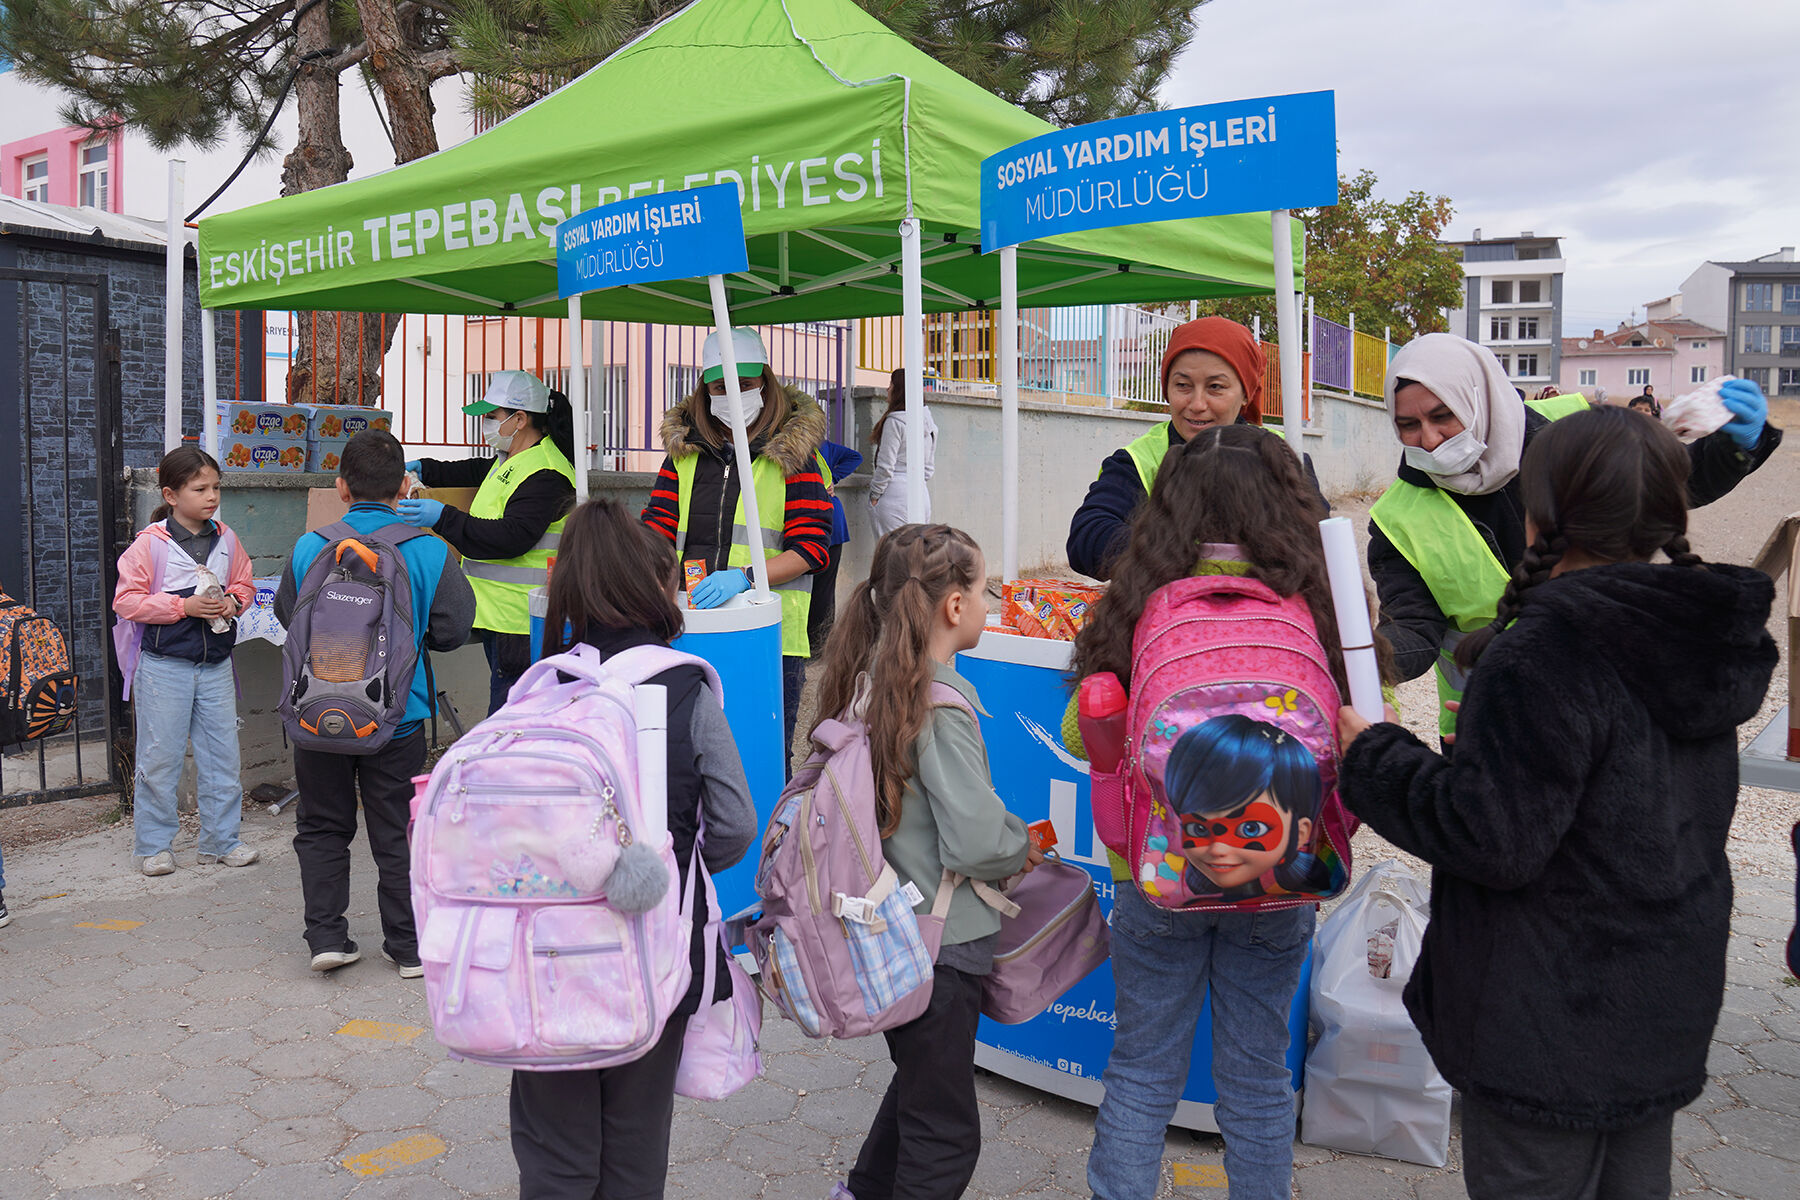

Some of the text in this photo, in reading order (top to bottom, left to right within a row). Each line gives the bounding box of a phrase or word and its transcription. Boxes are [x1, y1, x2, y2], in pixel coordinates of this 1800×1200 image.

[997, 105, 1278, 191] SOSYAL YARDIM İŞLERİ
[563, 195, 702, 252] SOSYAL YARDIM İŞLERİ
[1026, 163, 1209, 225] MÜDÜRLÜĞÜ
[210, 225, 356, 289] ESKİŞEHİR
[576, 239, 664, 281] MÜDÜRLÜĞÜ
[326, 591, 373, 605] Slazenger
